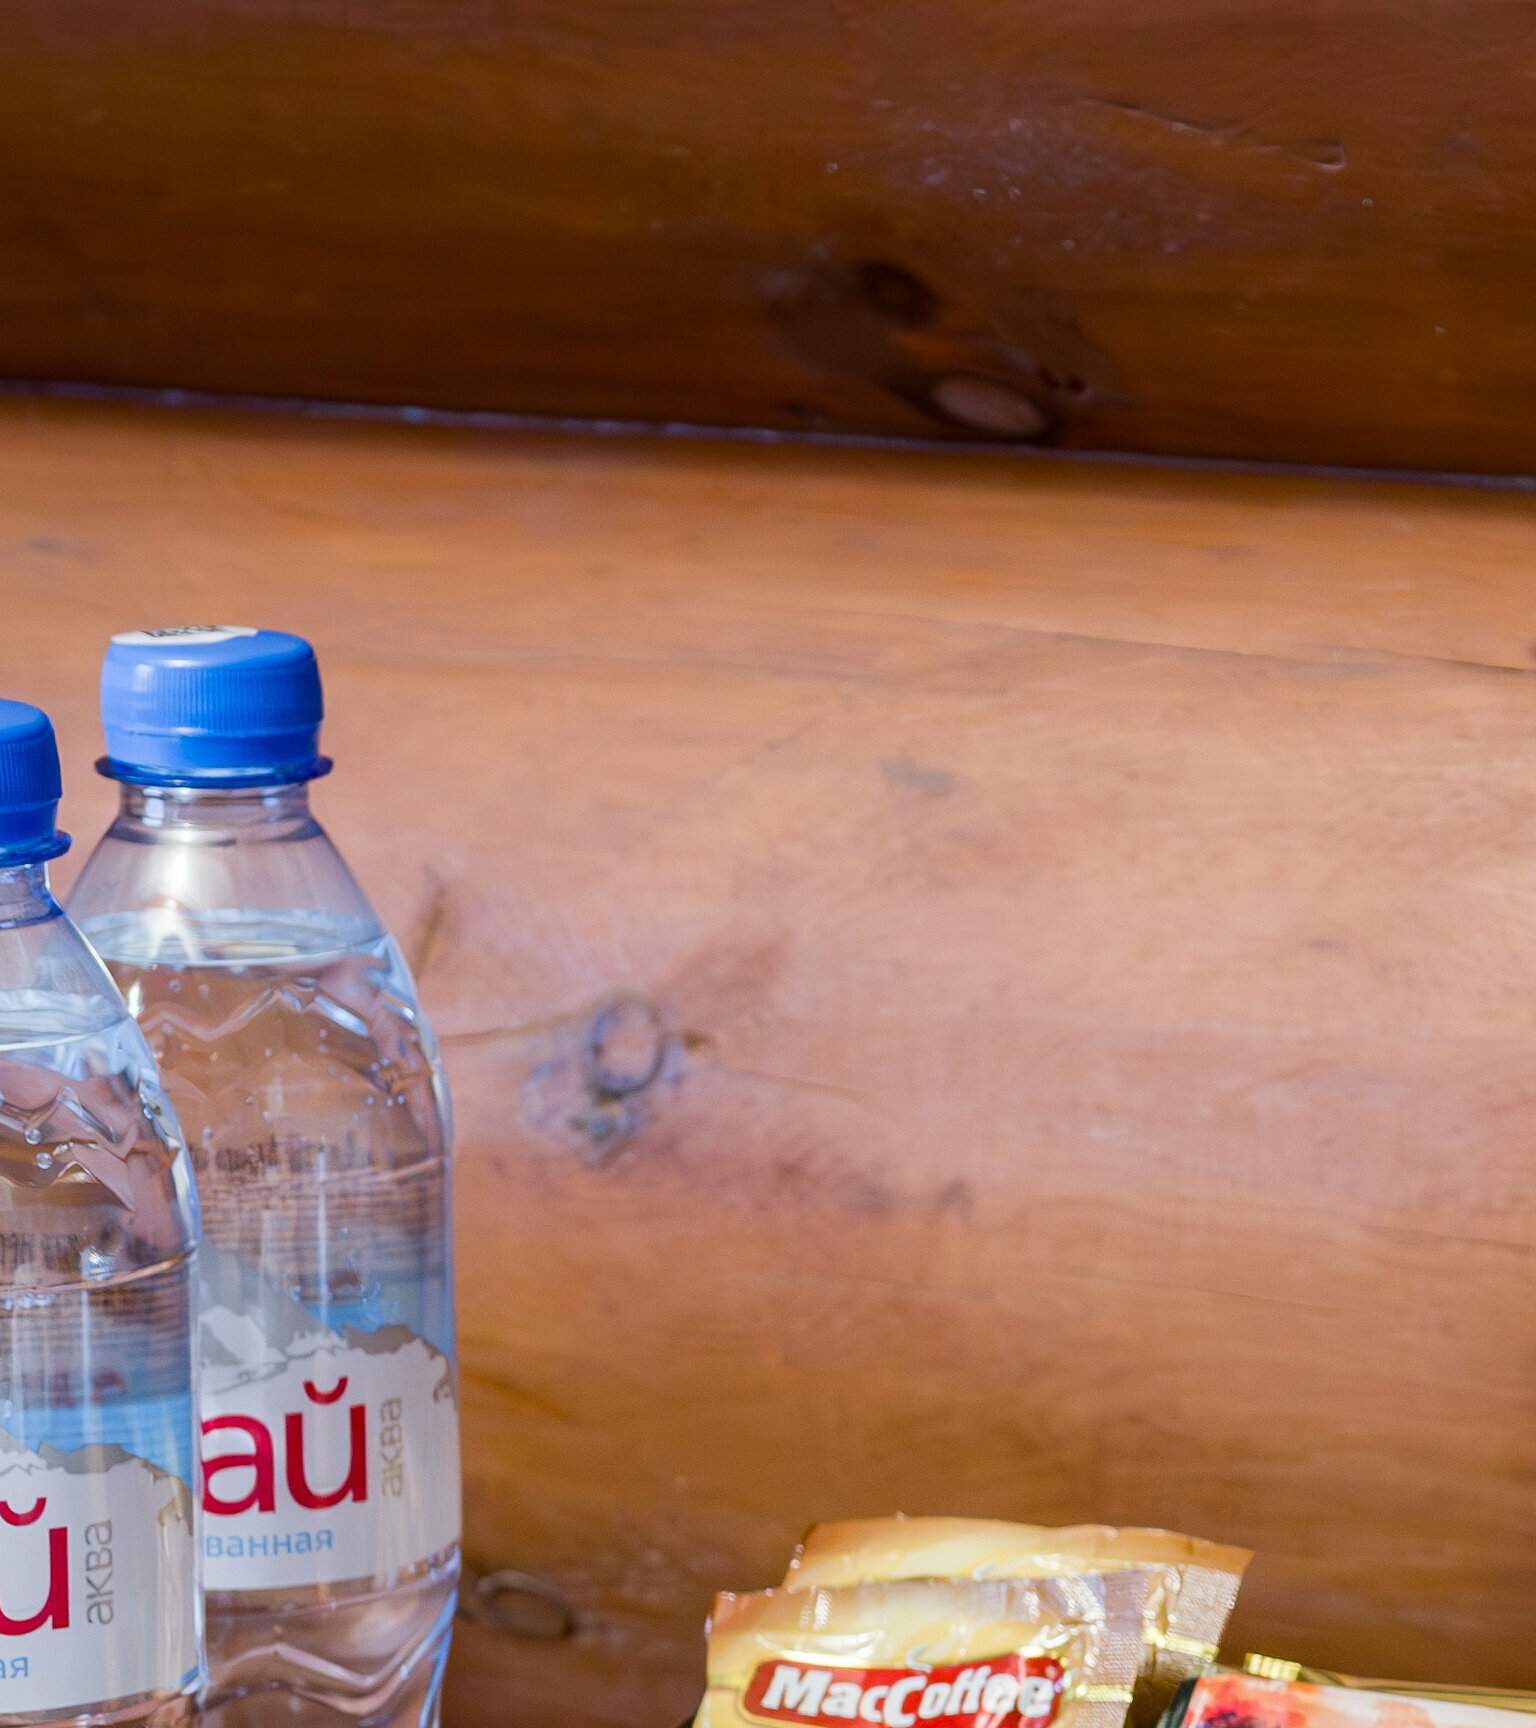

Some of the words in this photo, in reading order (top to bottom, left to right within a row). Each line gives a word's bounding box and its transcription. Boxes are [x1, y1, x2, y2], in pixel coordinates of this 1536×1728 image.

[201, 1375, 367, 1516] ай
[379, 1397, 404, 1497] аква
[84, 1519, 114, 1625] аква
[760, 1664, 1056, 1728] MacCoffee
